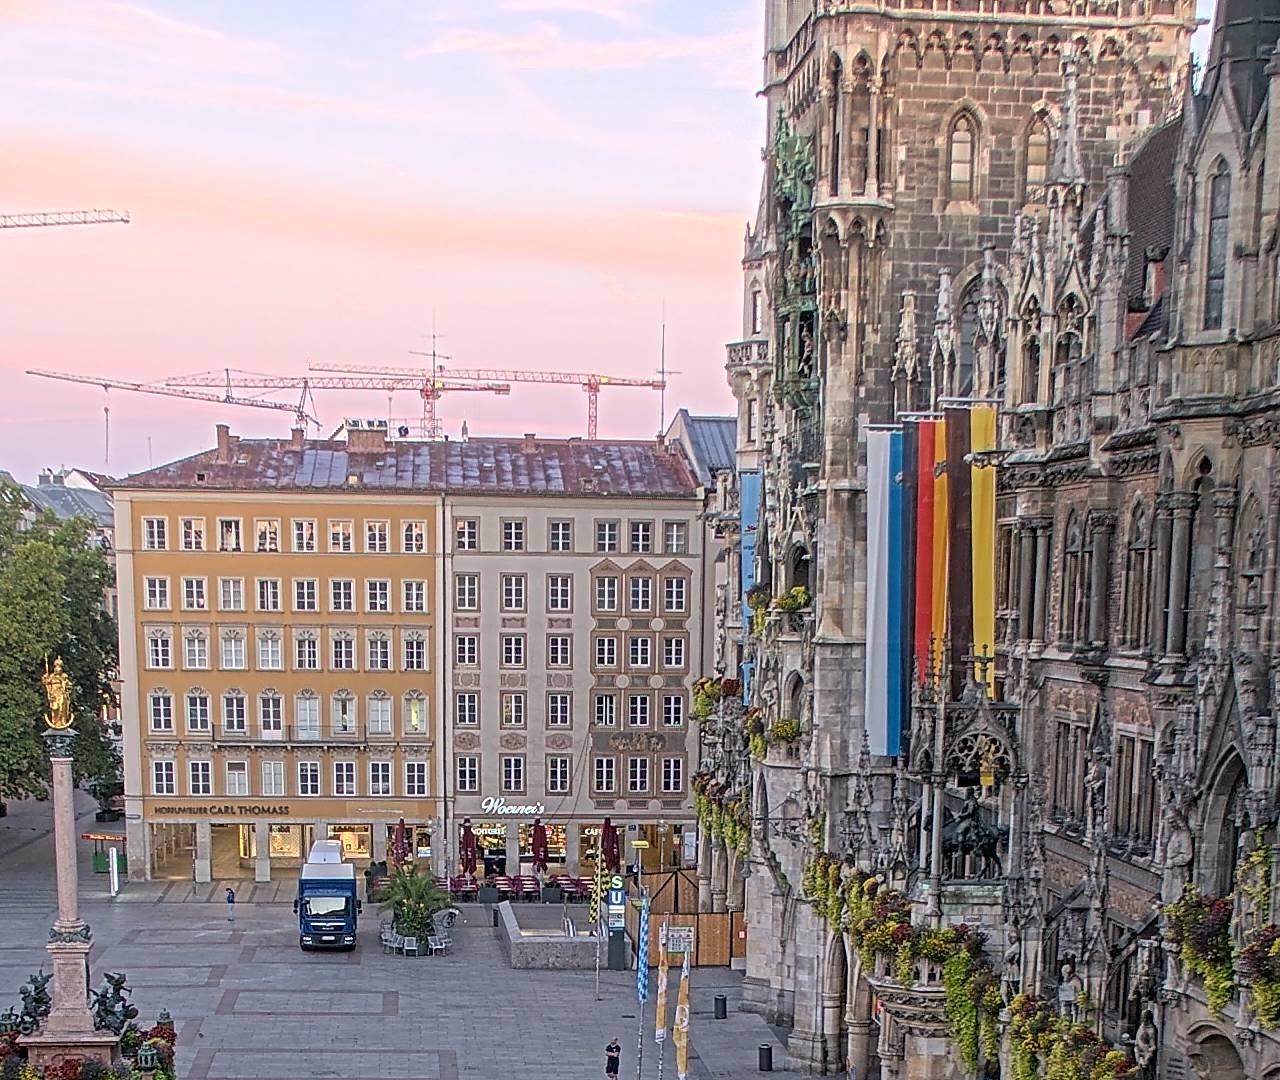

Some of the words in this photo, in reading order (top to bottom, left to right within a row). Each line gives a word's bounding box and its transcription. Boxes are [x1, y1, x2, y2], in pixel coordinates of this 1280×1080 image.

[209, 804, 237, 816] CARL
[238, 804, 290, 816] THOMASS
[611, 875, 622, 889] S
[611, 891, 621, 904] U
